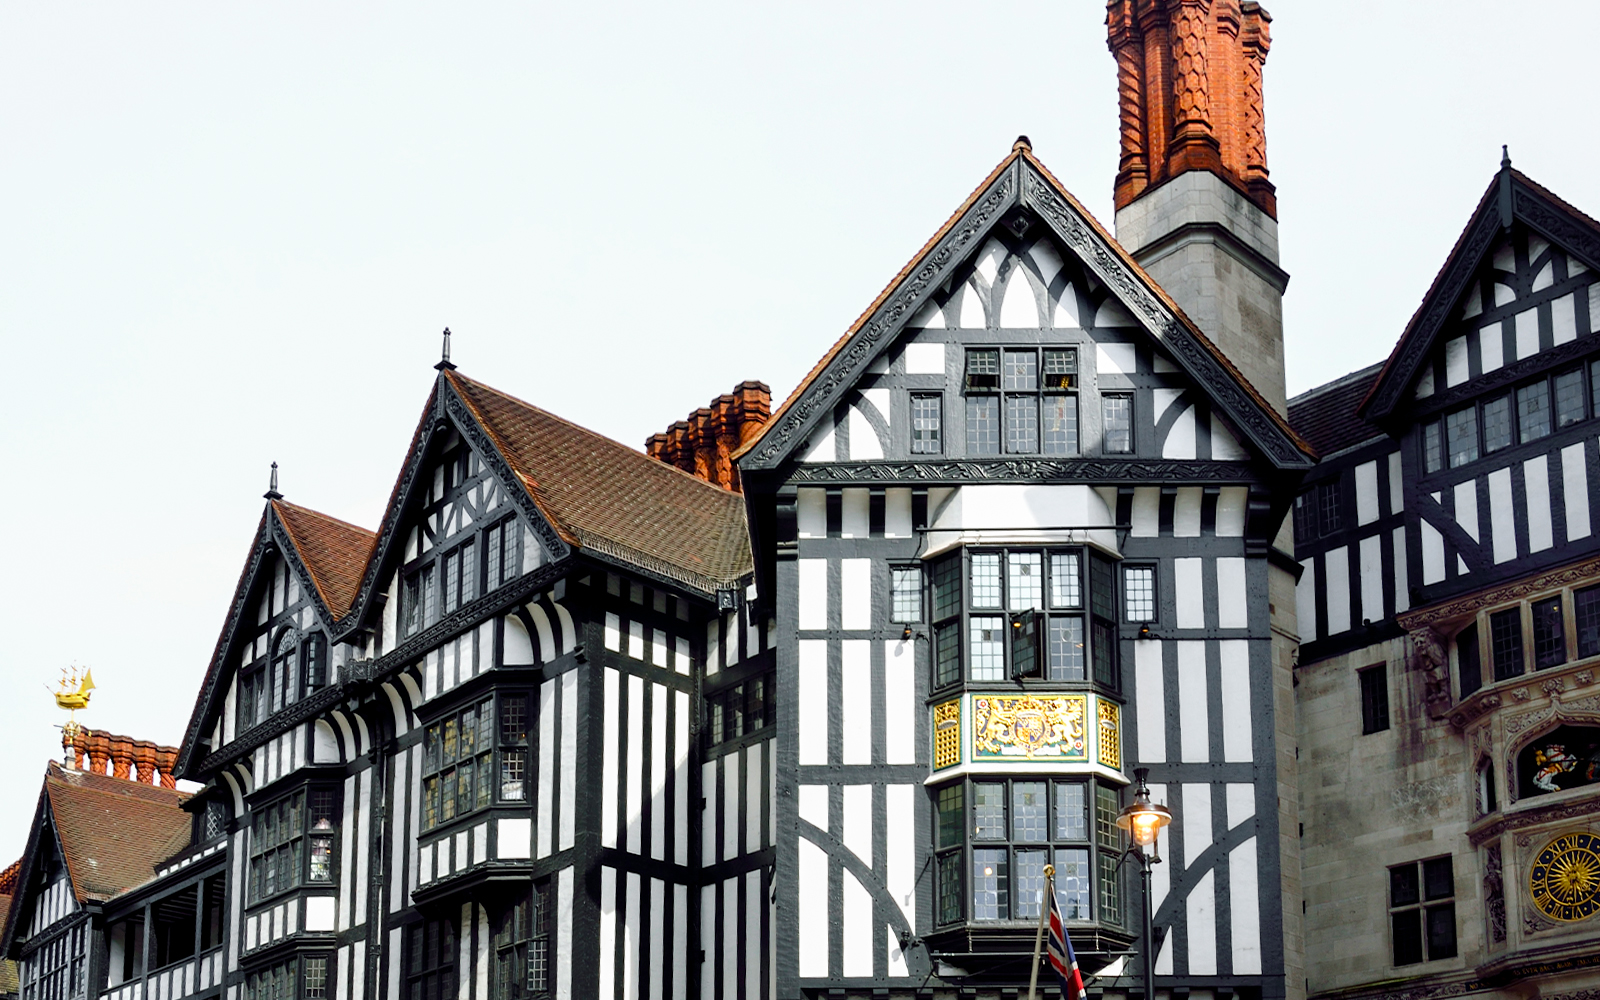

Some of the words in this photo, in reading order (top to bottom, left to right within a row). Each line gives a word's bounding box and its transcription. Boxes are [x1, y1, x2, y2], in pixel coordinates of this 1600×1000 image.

[1564, 835, 1578, 848] XII
[1547, 842, 1561, 857] XI
[1536, 859, 1548, 871] X
[1532, 878, 1545, 890] IX
[1551, 903, 1564, 918] VII
[1571, 905, 1585, 919] VI
